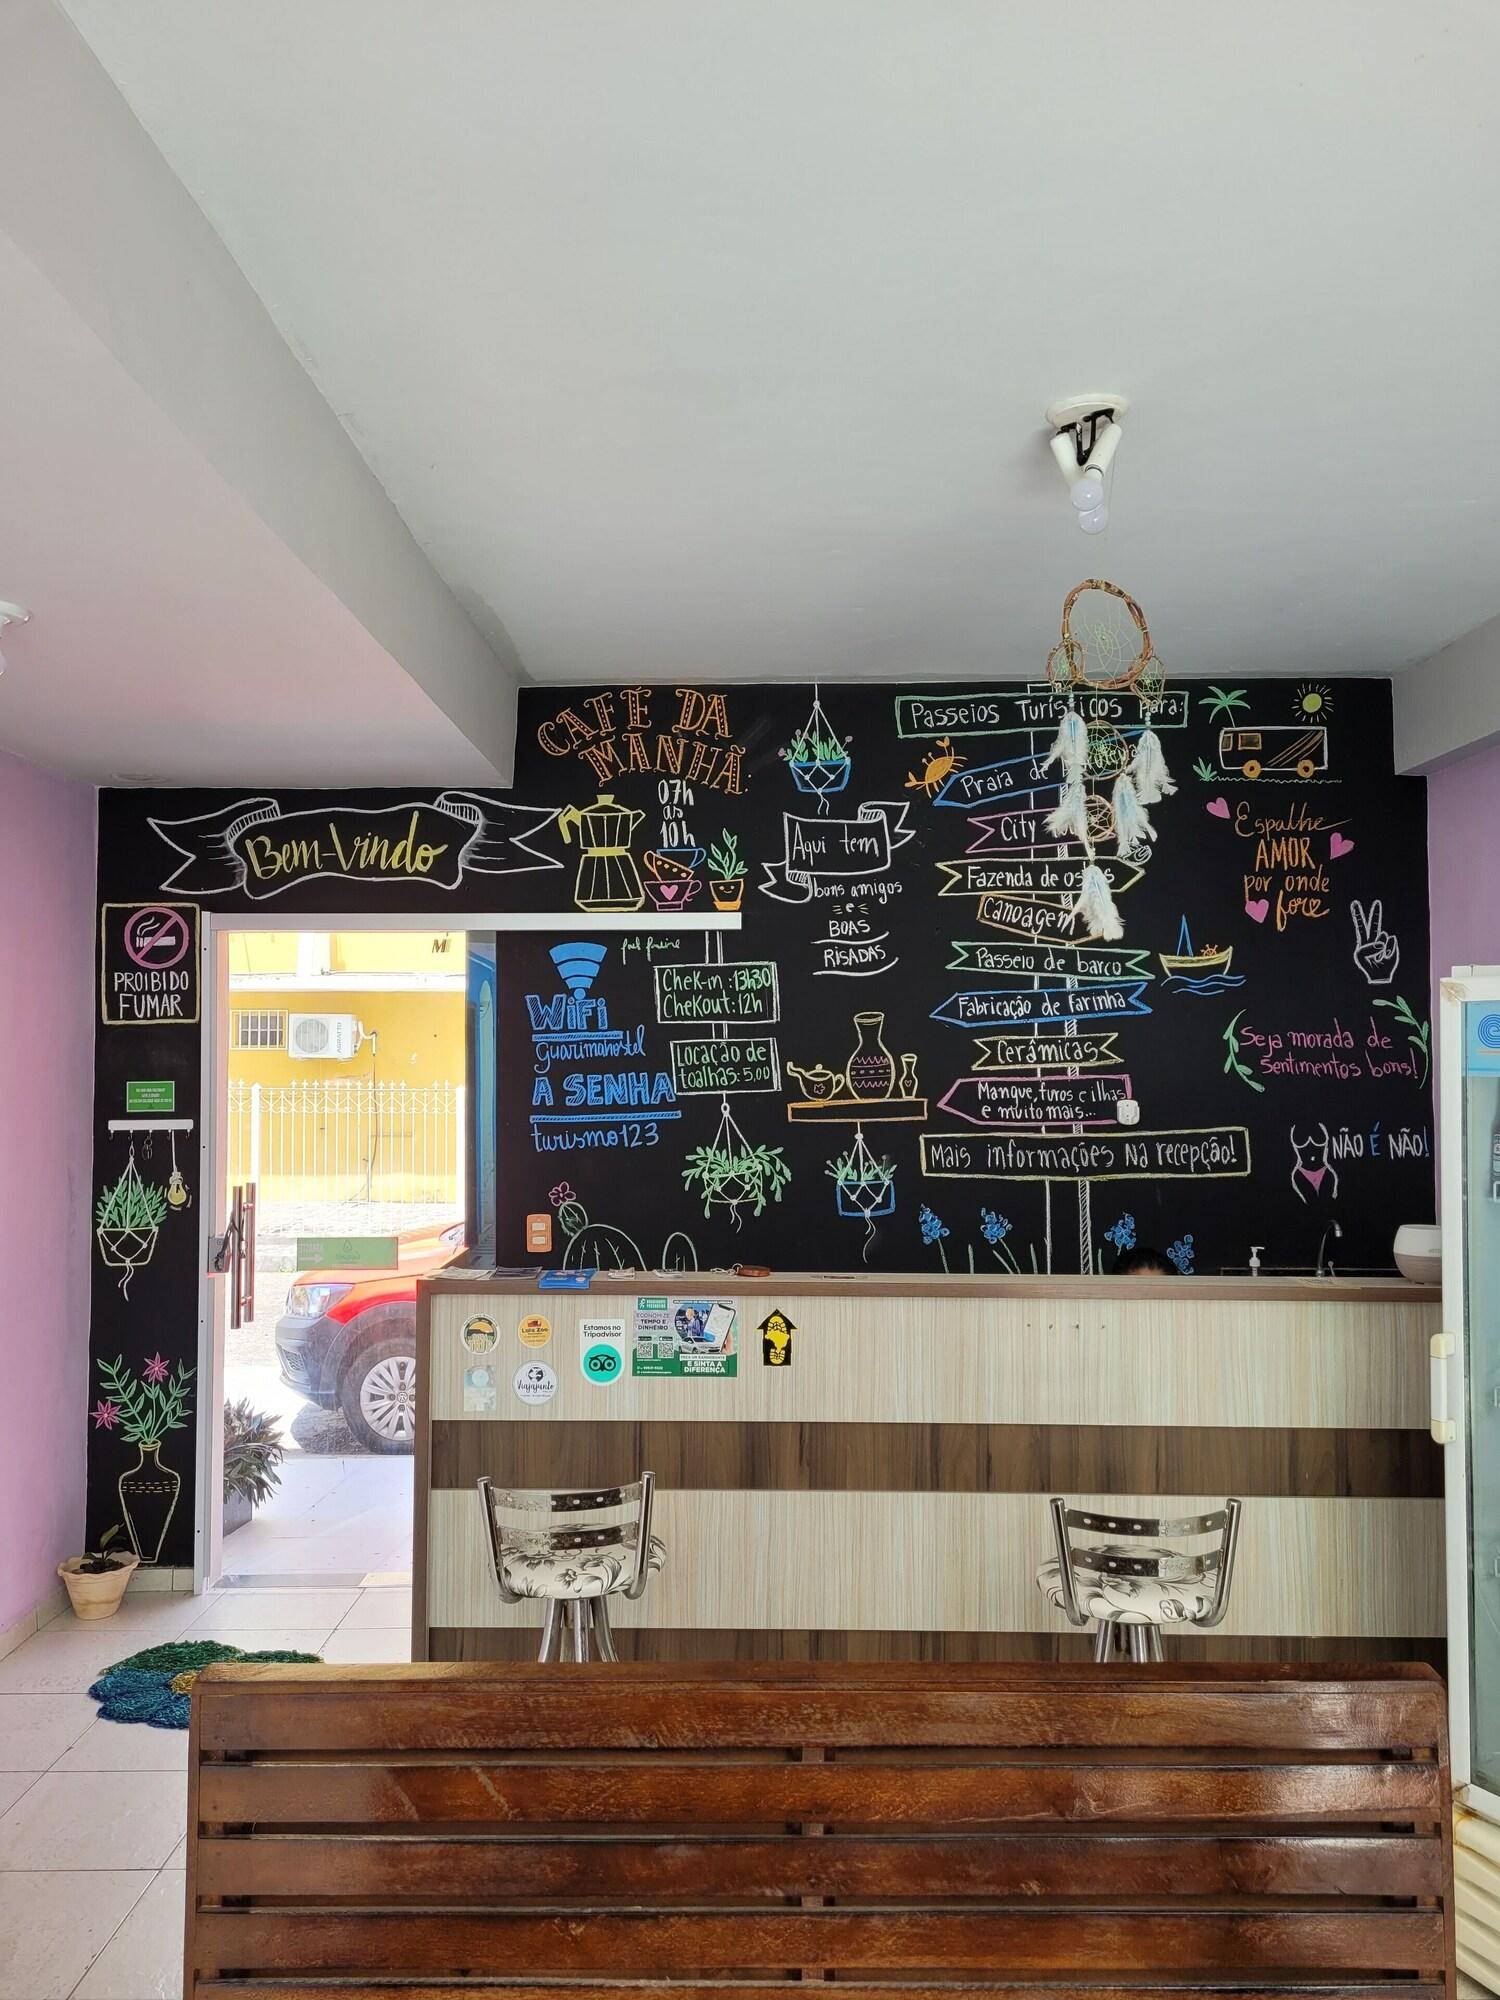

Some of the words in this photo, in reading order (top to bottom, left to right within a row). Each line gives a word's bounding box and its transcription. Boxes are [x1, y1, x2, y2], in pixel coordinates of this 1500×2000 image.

[538, 686, 652, 755] CAFÉ
[672, 688, 733, 739] DA
[911, 702, 1000, 728] Passeios
[1014, 696, 1122, 721] Turísicos
[658, 779, 694, 806] 07h
[961, 769, 1013, 798] Praia
[659, 822, 695, 848] 10h
[1001, 813, 1036, 843] City
[1235, 801, 1352, 840] Espalhe
[245, 811, 449, 880] Bem-Vindo
[792, 822, 826, 866] Aqui
[839, 824, 879, 857] tem
[1255, 837, 1315, 872] AMOR
[968, 865, 1033, 889] Fazenda
[1040, 865, 1059, 888] de
[1064, 861, 1115, 888] oss
[1244, 874, 1272, 902] por
[1285, 864, 1330, 892] onde
[814, 877, 845, 898] bons
[851, 879, 903, 904] amigos
[845, 902, 855, 913] e
[982, 898, 1075, 935] Canoagem
[829, 919, 871, 938] BOAS
[976, 948, 1034, 970] Passeio
[1044, 947, 1066, 972] de
[1077, 951, 1122, 976] barco
[114, 971, 188, 992] PROIBIDO
[119, 994, 183, 1019] FUMAR
[525, 994, 608, 1031] WiFi
[959, 994, 1032, 1018] Fabricação
[1042, 993, 1060, 1016] de
[1240, 1026, 1282, 1058] Seja
[1287, 1017, 1354, 1048] morada
[1367, 1016, 1393, 1048] de
[677, 1041, 741, 1068] Locação
[747, 1042, 768, 1062] de
[998, 1040, 1099, 1064] Cerâmicas
[1365, 1048, 1418, 1079] bons!
[563, 1072, 676, 1106] SENHA
[678, 1066, 741, 1089] toalhas:
[978, 1081, 1037, 1108] Mangue,
[1039, 1082, 1073, 1101] furos
[1079, 1091, 1087, 1102] e
[1091, 1081, 1126, 1102] ilhas
[982, 1105, 991, 1118] e
[998, 1103, 1043, 1119] muito
[931, 1144, 970, 1169] Mais
[988, 1139, 1113, 1173] informações
[1156, 1135, 1237, 1172] recepção!
[1332, 1127, 1363, 1159] NÃO
[1370, 1121, 1381, 1156] É
[1389, 1126, 1430, 1160] NÃO!
[684, 1366, 726, 1374] DIFERENÇA
